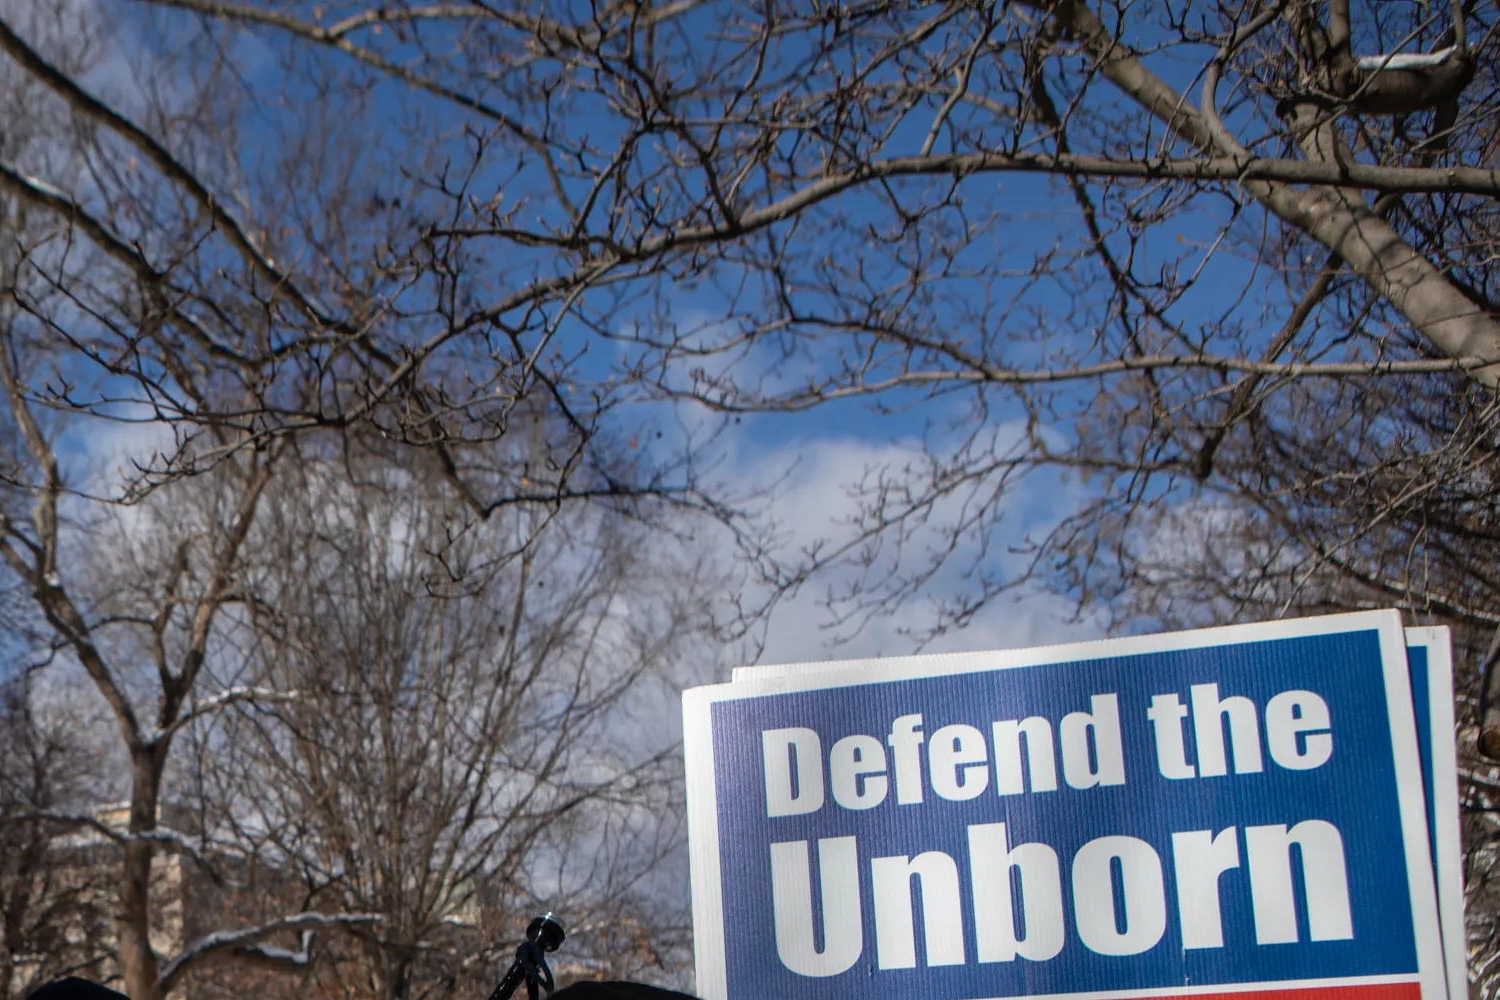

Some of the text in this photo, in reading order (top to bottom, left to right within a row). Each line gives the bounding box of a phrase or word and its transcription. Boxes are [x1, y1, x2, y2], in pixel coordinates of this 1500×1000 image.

[762, 682, 1334, 818] Defend the
[770, 818, 1354, 979] Unborn
